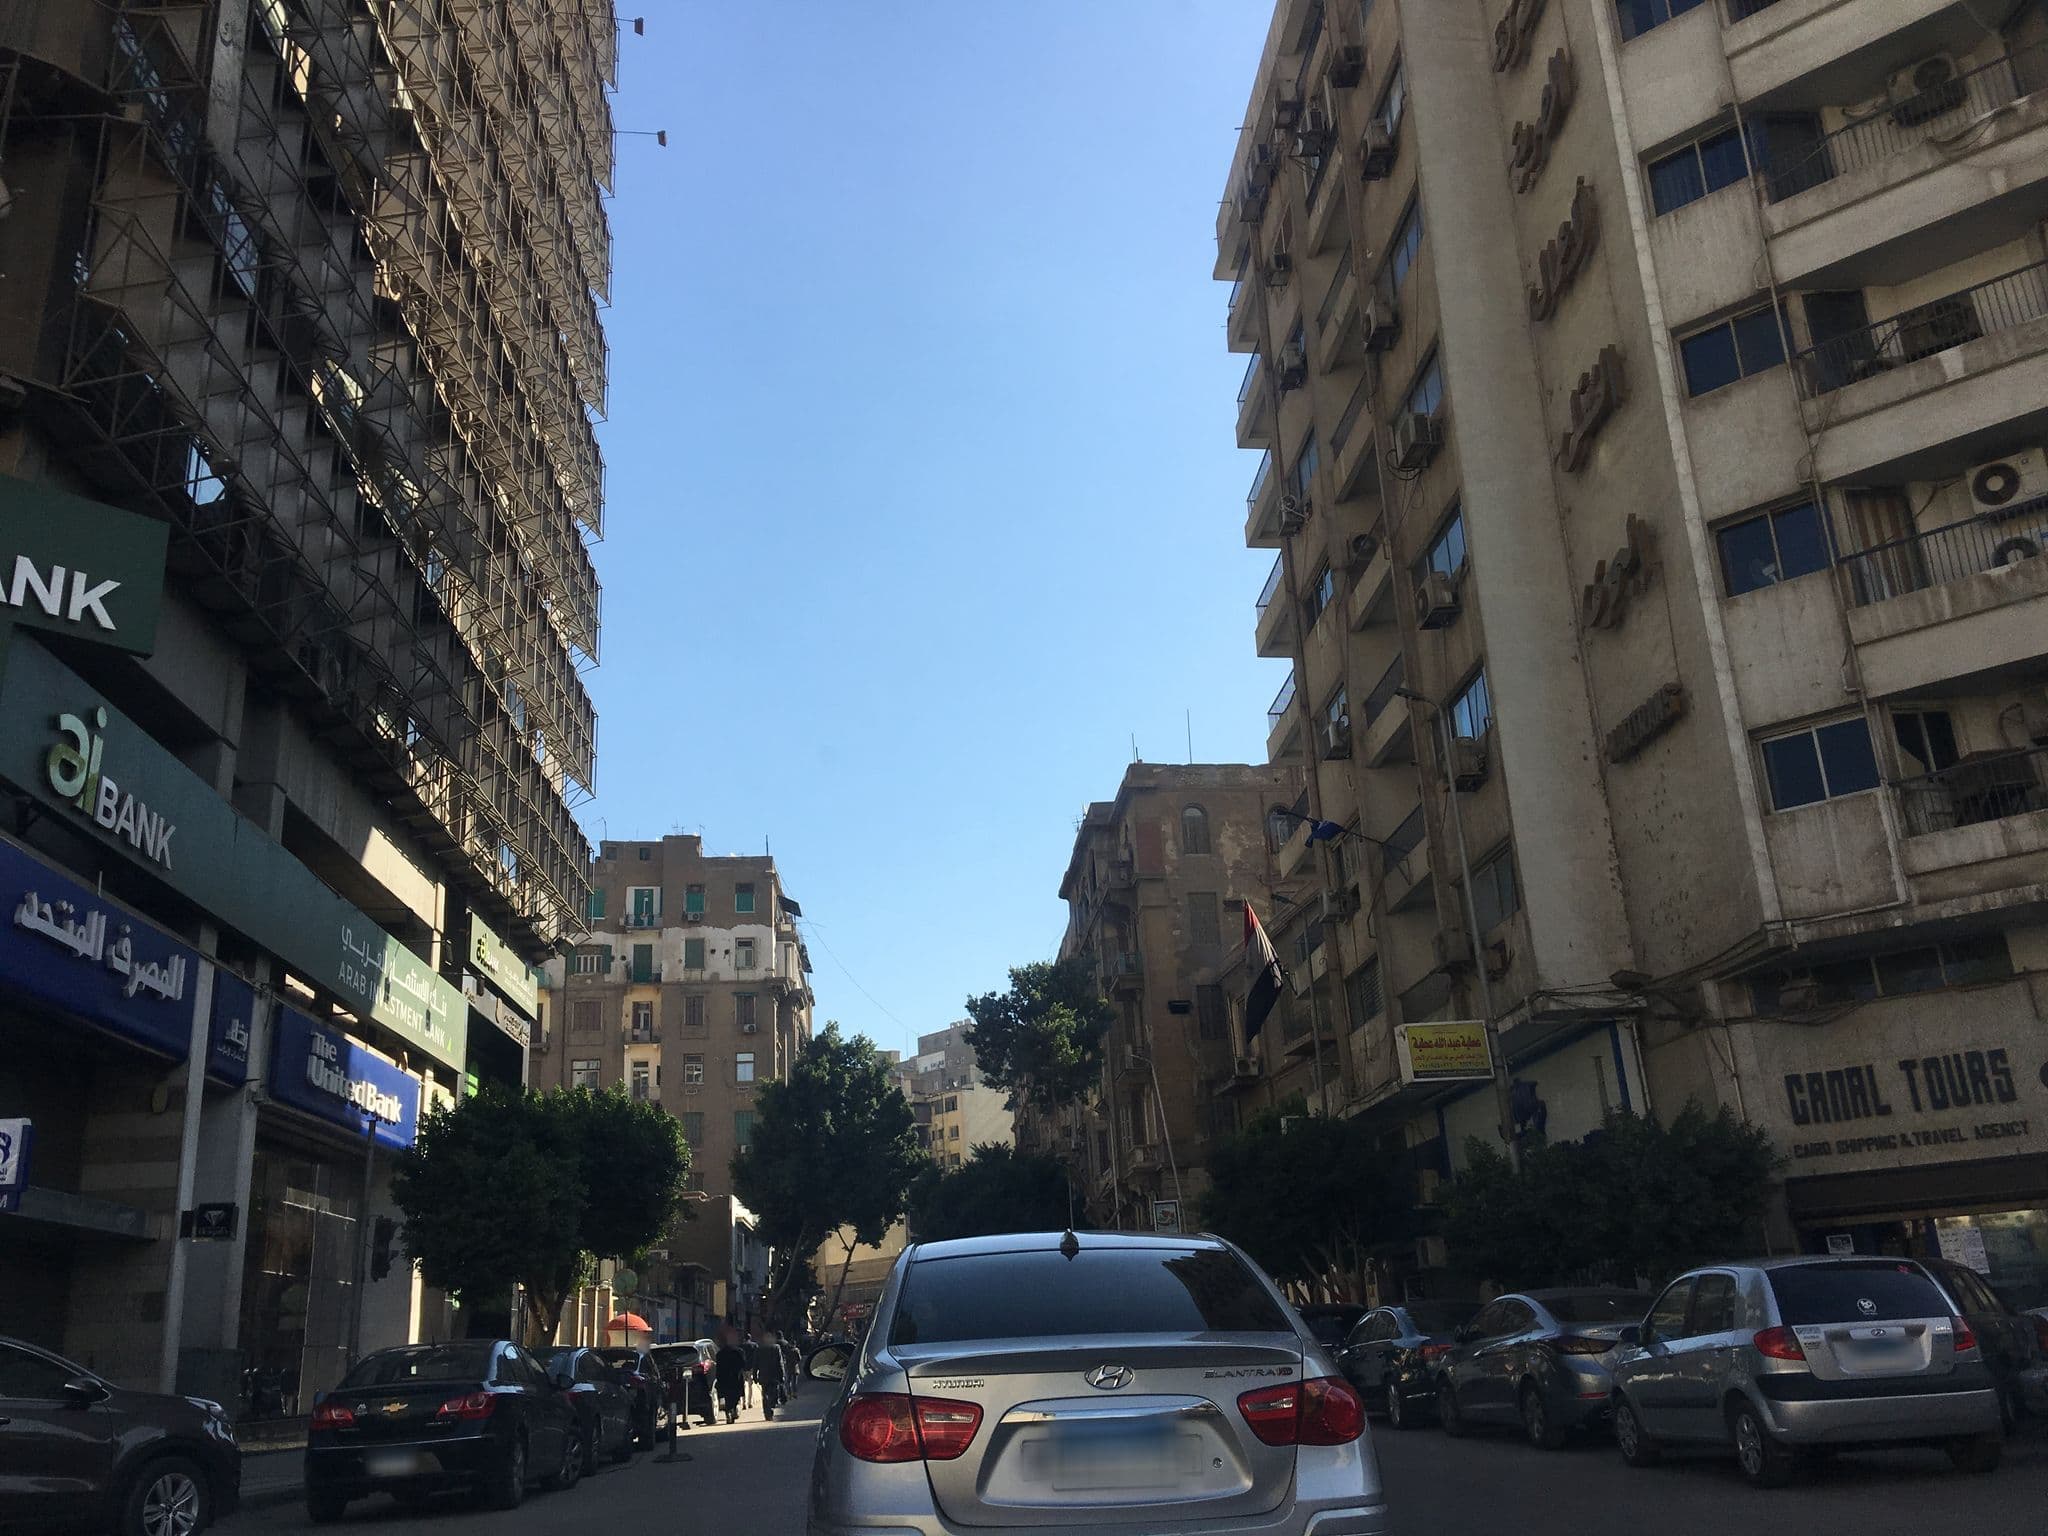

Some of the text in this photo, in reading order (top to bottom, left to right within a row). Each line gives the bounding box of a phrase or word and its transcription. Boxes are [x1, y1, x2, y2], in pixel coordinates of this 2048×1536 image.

[0, 555, 122, 631] NK
[94, 775, 176, 870] BANK
[14, 891, 186, 1000] المصرف المتحد
[341, 925, 388, 974] العربي
[338, 961, 366, 994] ARAB
[310, 1031, 337, 1062] The
[1784, 1048, 2018, 1125] CANAL TOURS
[1793, 1141, 1832, 1159] CAIRO
[1836, 1134, 1897, 1155] SHIPPING
[1914, 1127, 1969, 1147] TRAVEL
[1974, 1119, 2031, 1140] AGENCY
